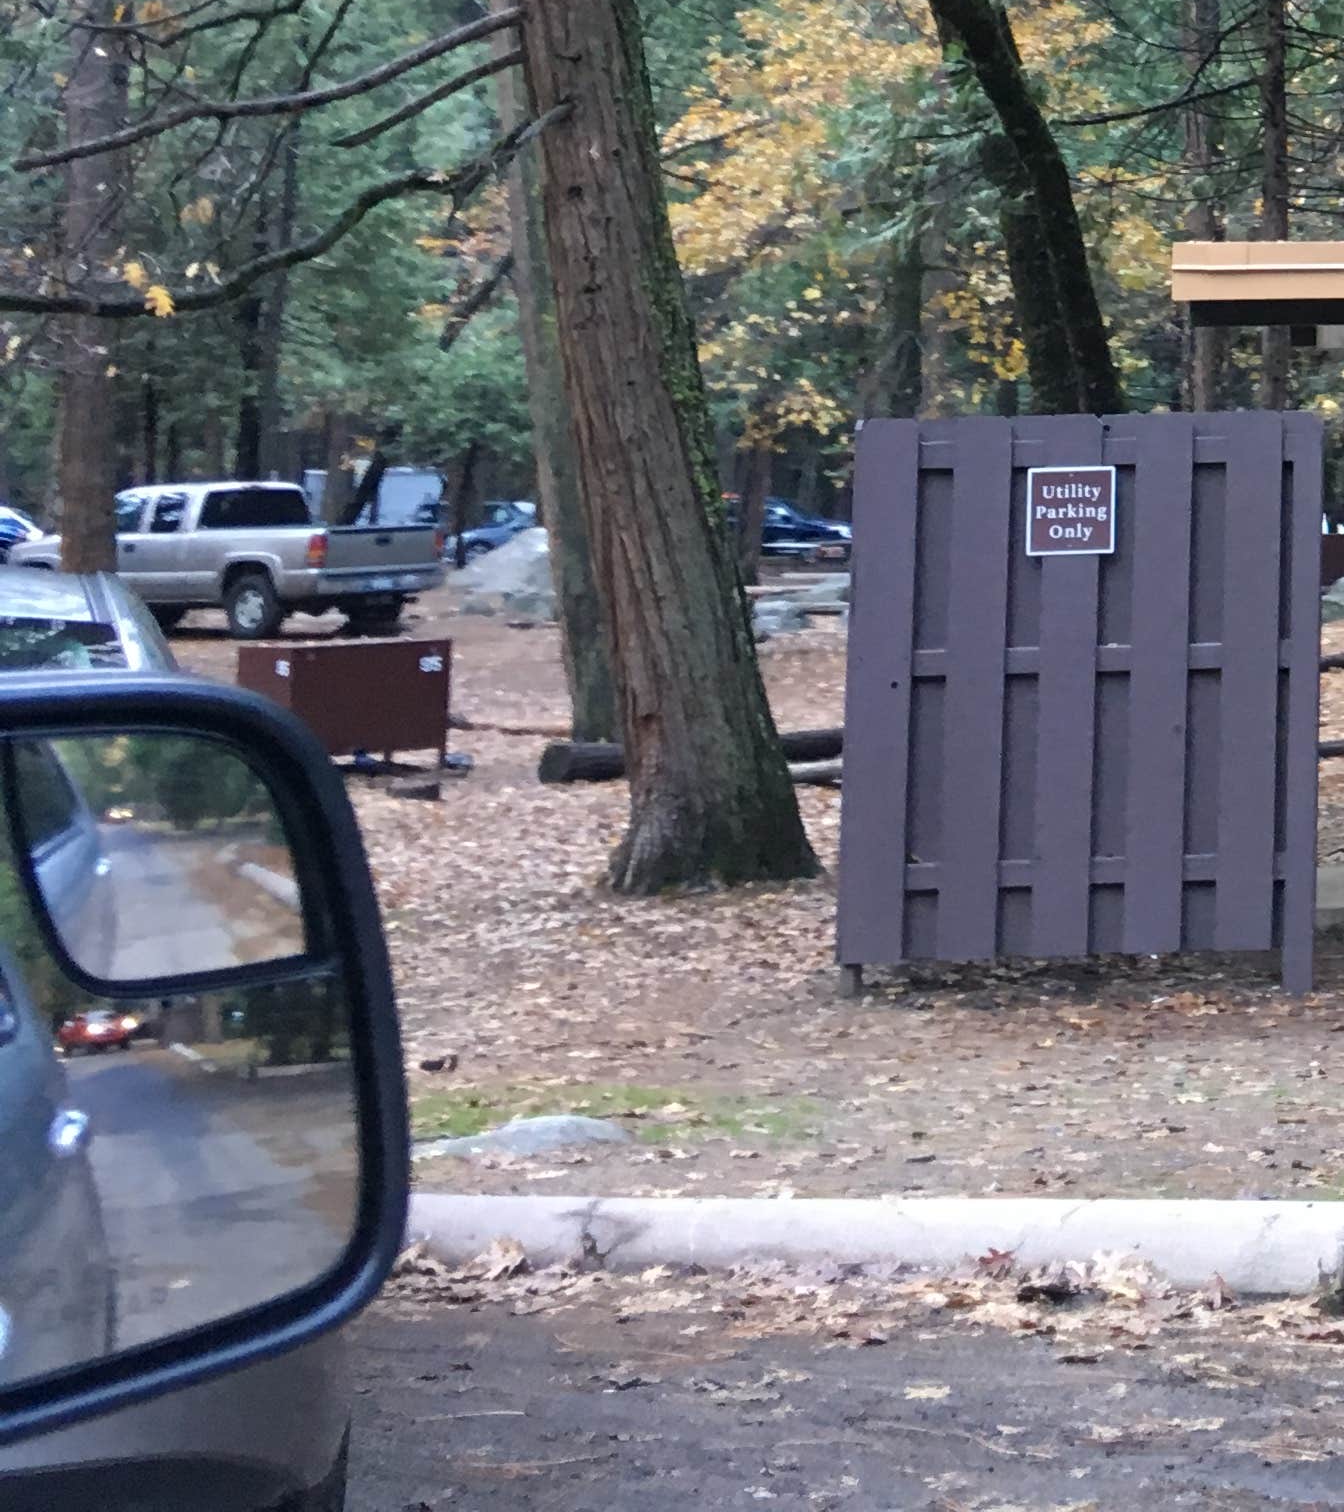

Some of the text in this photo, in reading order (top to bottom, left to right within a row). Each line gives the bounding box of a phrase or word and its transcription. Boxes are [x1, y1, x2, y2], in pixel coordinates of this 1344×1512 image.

[1042, 483, 1101, 501] Utility
[1035, 503, 1107, 521] Parking
[1048, 522, 1093, 541] Only
